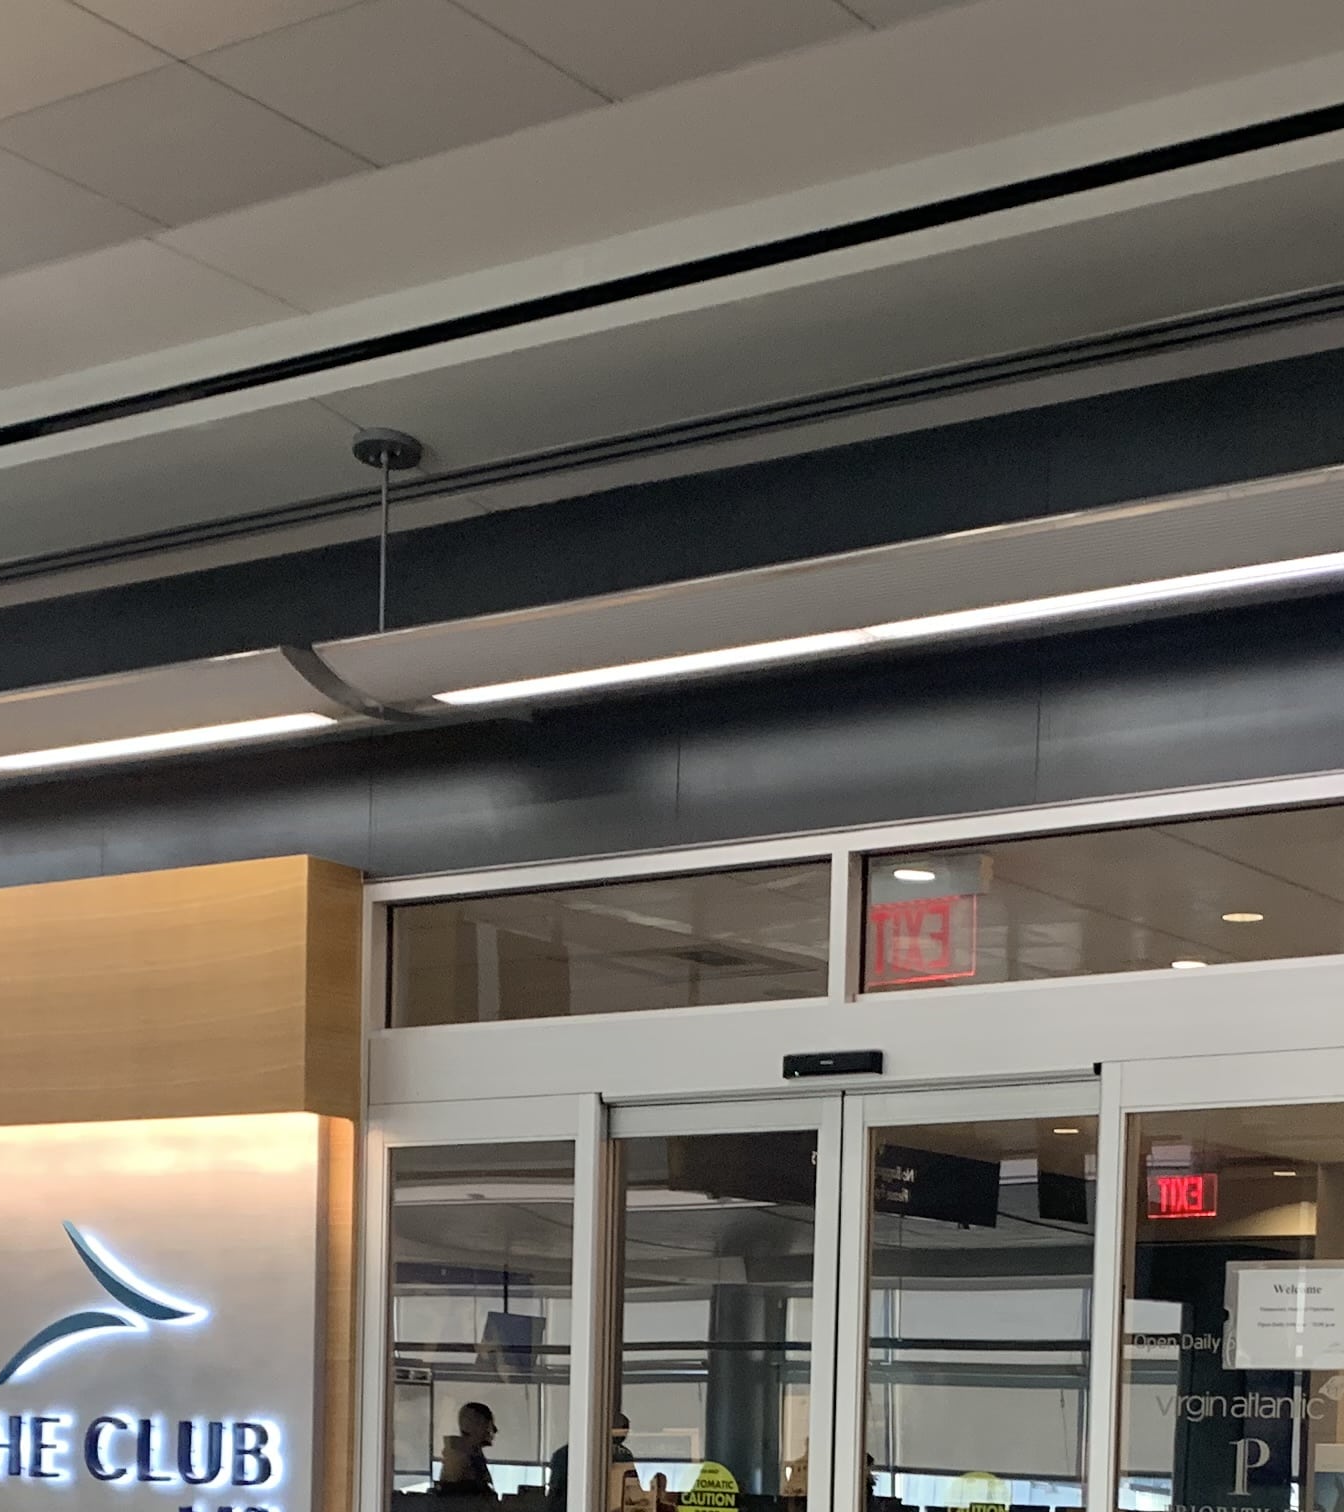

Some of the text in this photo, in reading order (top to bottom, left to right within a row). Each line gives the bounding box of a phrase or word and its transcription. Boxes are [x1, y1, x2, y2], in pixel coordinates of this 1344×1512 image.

[1273, 1284, 1323, 1295] Welcme
[1182, 1333, 1221, 1355] Daily
[84, 1416, 272, 1486] CLUB
[686, 1478, 735, 1490] TOMATIC
[681, 1492, 736, 1507] CAUTION
